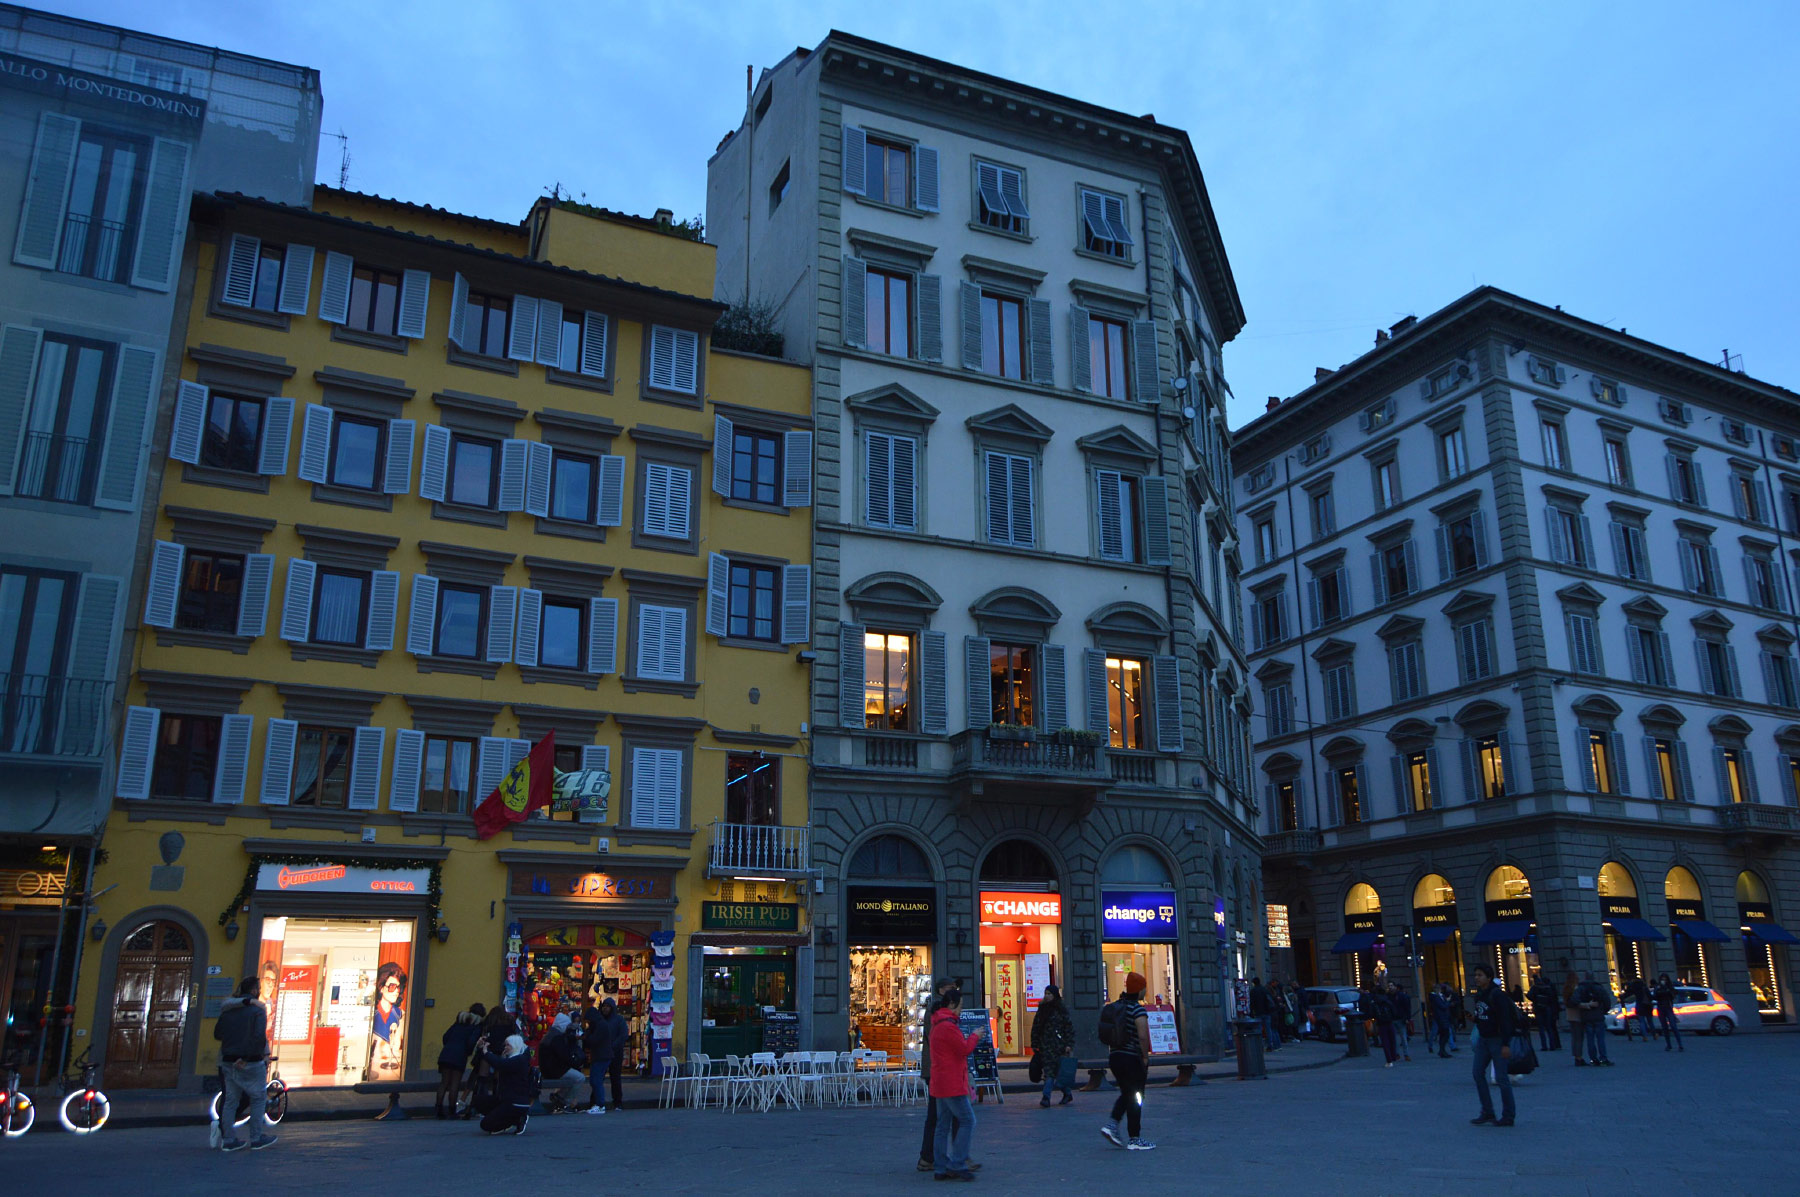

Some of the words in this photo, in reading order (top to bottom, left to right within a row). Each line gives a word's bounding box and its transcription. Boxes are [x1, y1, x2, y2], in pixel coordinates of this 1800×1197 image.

[56, 73, 201, 118] MONTEDOMINI
[370, 880, 414, 891] OTTICA
[569, 878, 654, 896] CIPRESSI
[711, 905, 754, 920] IRISH
[760, 906, 790, 921] PUB
[892, 902, 929, 911] ITALIANO
[993, 900, 1059, 916] CHANGE
[1497, 908, 1523, 917] PRADA
[1609, 905, 1631, 914] PRADA
[1676, 908, 1696, 916] PRADA
[1104, 905, 1156, 922] change
[1424, 915, 1447, 923] PRADA
[1002, 964, 1012, 1034] CHANGE
